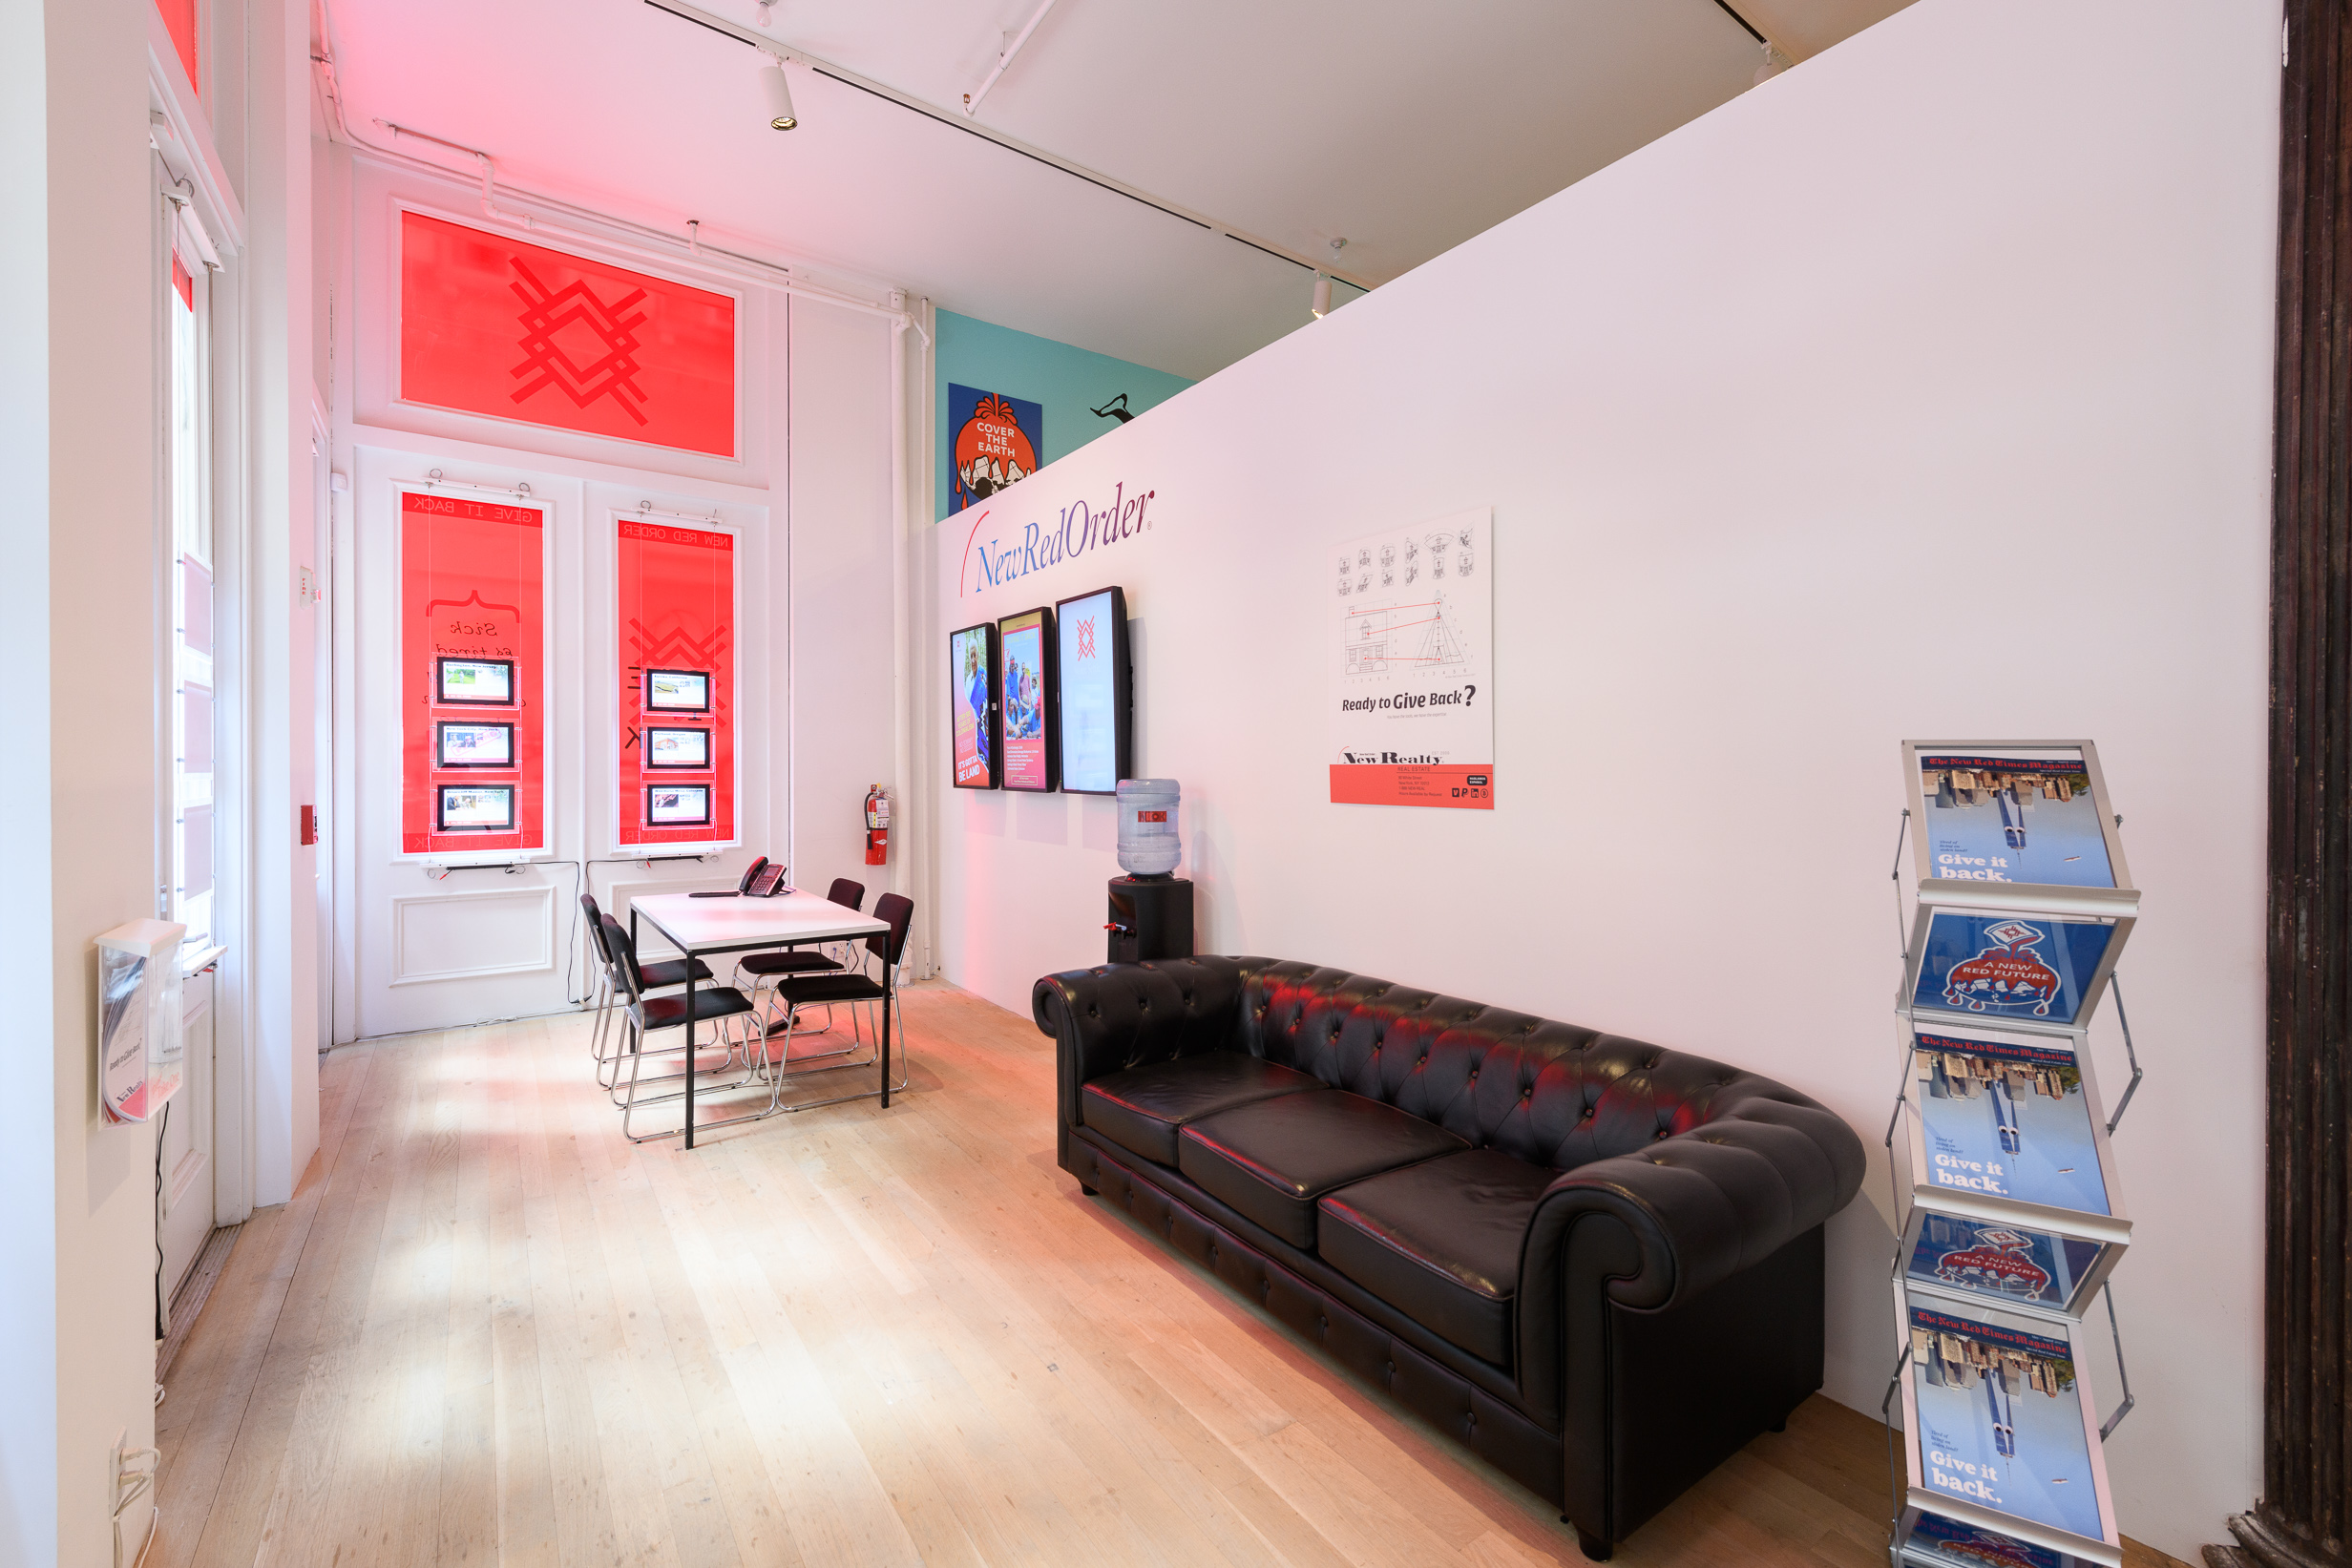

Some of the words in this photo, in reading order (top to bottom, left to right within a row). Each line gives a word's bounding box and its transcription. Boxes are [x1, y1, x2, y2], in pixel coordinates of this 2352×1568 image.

[976, 422, 1015, 438] COVER
[985, 433, 1008, 447] THE
[977, 442, 1016, 457] EARTH
[1342, 697, 1376, 713] Ready
[1378, 698, 1391, 709] to
[1394, 692, 1426, 709] Give
[1343, 752, 1378, 764] New
[1380, 751, 1443, 766] Realty
[1995, 759, 2027, 767] Times
[2029, 762, 2082, 770] Magazine
[958, 769, 966, 783] BE
[966, 763, 979, 780] LAND
[1938, 854, 1986, 866] Give
[1990, 856, 2008, 868] it
[1939, 866, 2012, 883] back.
[1994, 970, 2049, 980] FUTURE
[1998, 962, 2032, 971] NEW
[1922, 1035, 1940, 1045] The
[1942, 1038, 1963, 1049] New
[1965, 1042, 1984, 1052] Red
[1986, 1044, 2019, 1056] Times
[2019, 1048, 2072, 1062] Magazine
[116, 1093, 129, 1102] New
[127, 1080, 143, 1095] Realty
[1935, 1154, 1982, 1172] Give
[1986, 1161, 2004, 1176] it
[1936, 1168, 2008, 1195] back.
[1954, 1255, 1981, 1264] RED
[1985, 1262, 2040, 1276] FUTURE
[1988, 1257, 2022, 1266] NEW
[1918, 1311, 1937, 1323] The
[1938, 1316, 1960, 1328] New
[1961, 1321, 1981, 1333] Red
[1982, 1327, 2014, 1341] Times
[2015, 1333, 2068, 1354] Magazine
[1930, 1451, 1977, 1475] Give
[1981, 1464, 1998, 1481] it
[1931, 1467, 2003, 1504] back.
